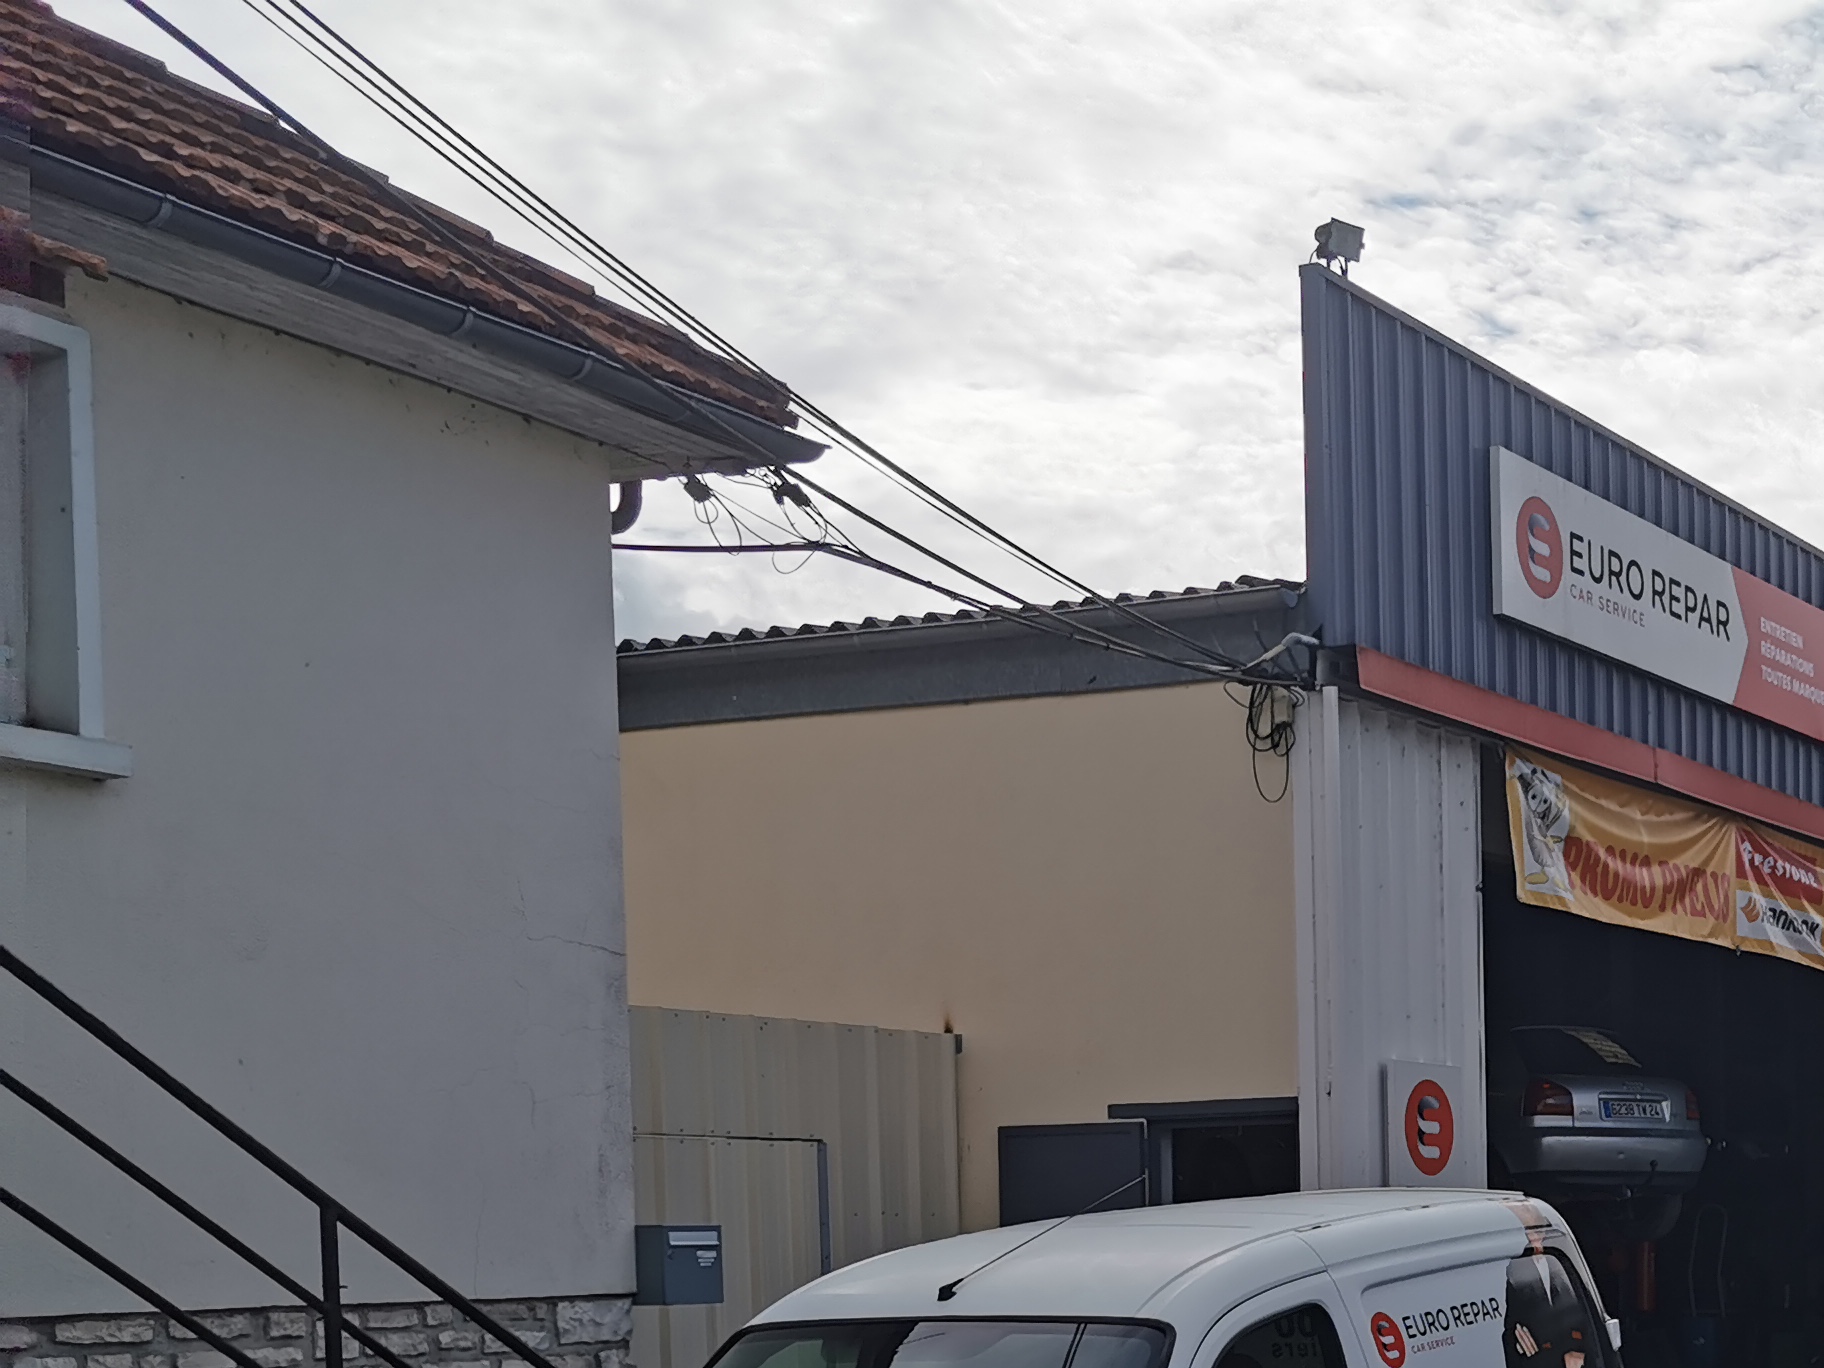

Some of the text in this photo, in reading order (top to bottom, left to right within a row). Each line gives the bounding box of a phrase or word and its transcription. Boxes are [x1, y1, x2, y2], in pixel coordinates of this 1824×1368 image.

[1569, 531, 1730, 642] EURO REPAR
[1570, 584, 1646, 628] CAR SERVICE
[1564, 835, 1731, 924] PROMO PNEUS
[1402, 1297, 1503, 1339] EURO REPAR
[1411, 1336, 1456, 1354] CAR SERVICE
